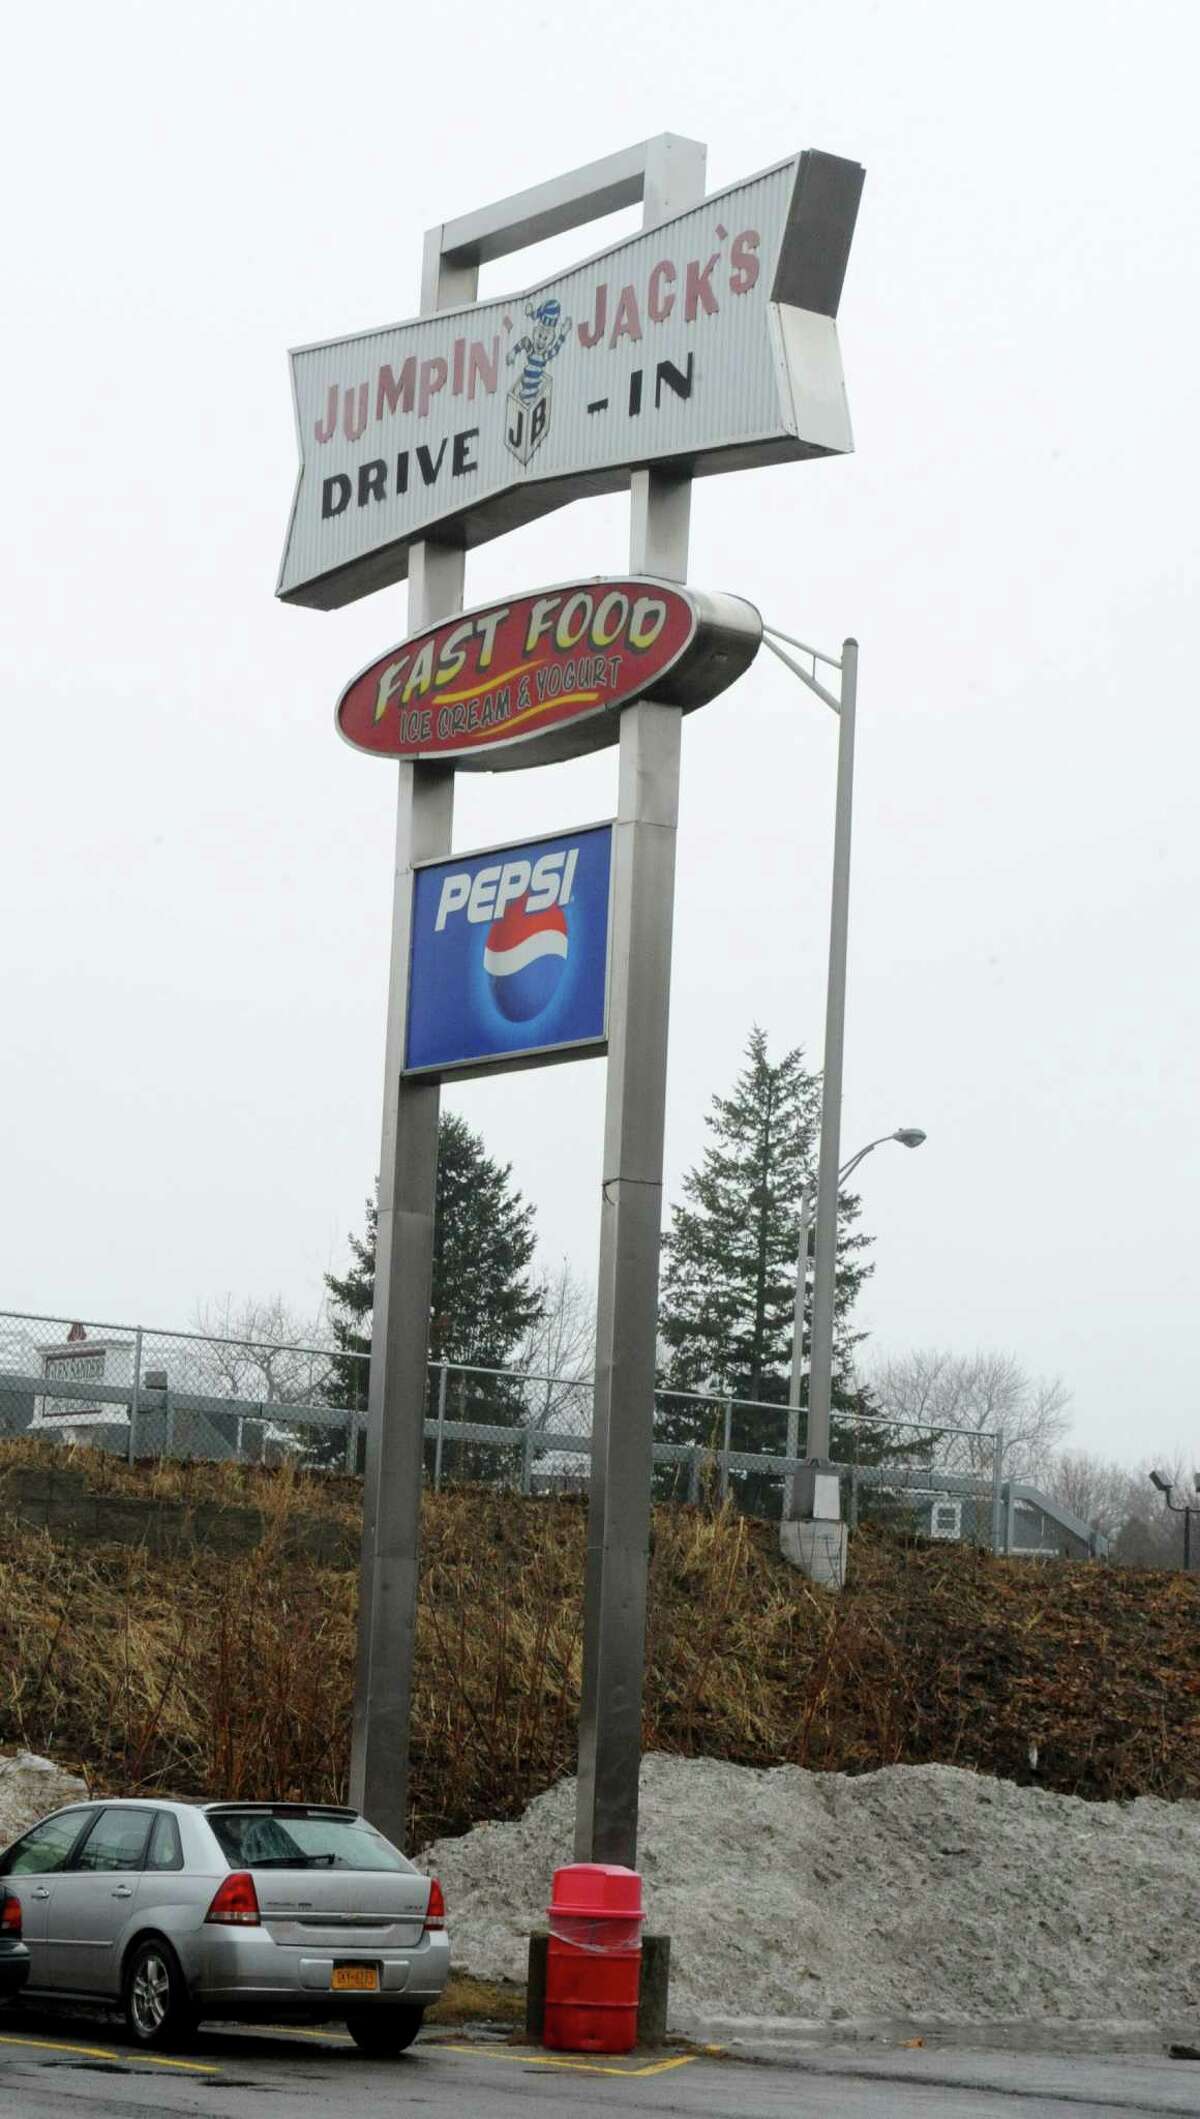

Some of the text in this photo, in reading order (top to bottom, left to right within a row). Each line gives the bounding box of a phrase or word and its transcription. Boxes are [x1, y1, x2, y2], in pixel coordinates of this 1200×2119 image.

[577, 223, 760, 350] JACK'S
[321, 427, 480, 519] DRIVE
[373, 592, 668, 726] FAST FOOD
[400, 656, 623, 743] ICE CREAM & YOGURT
[434, 848, 580, 932] PEPSI
